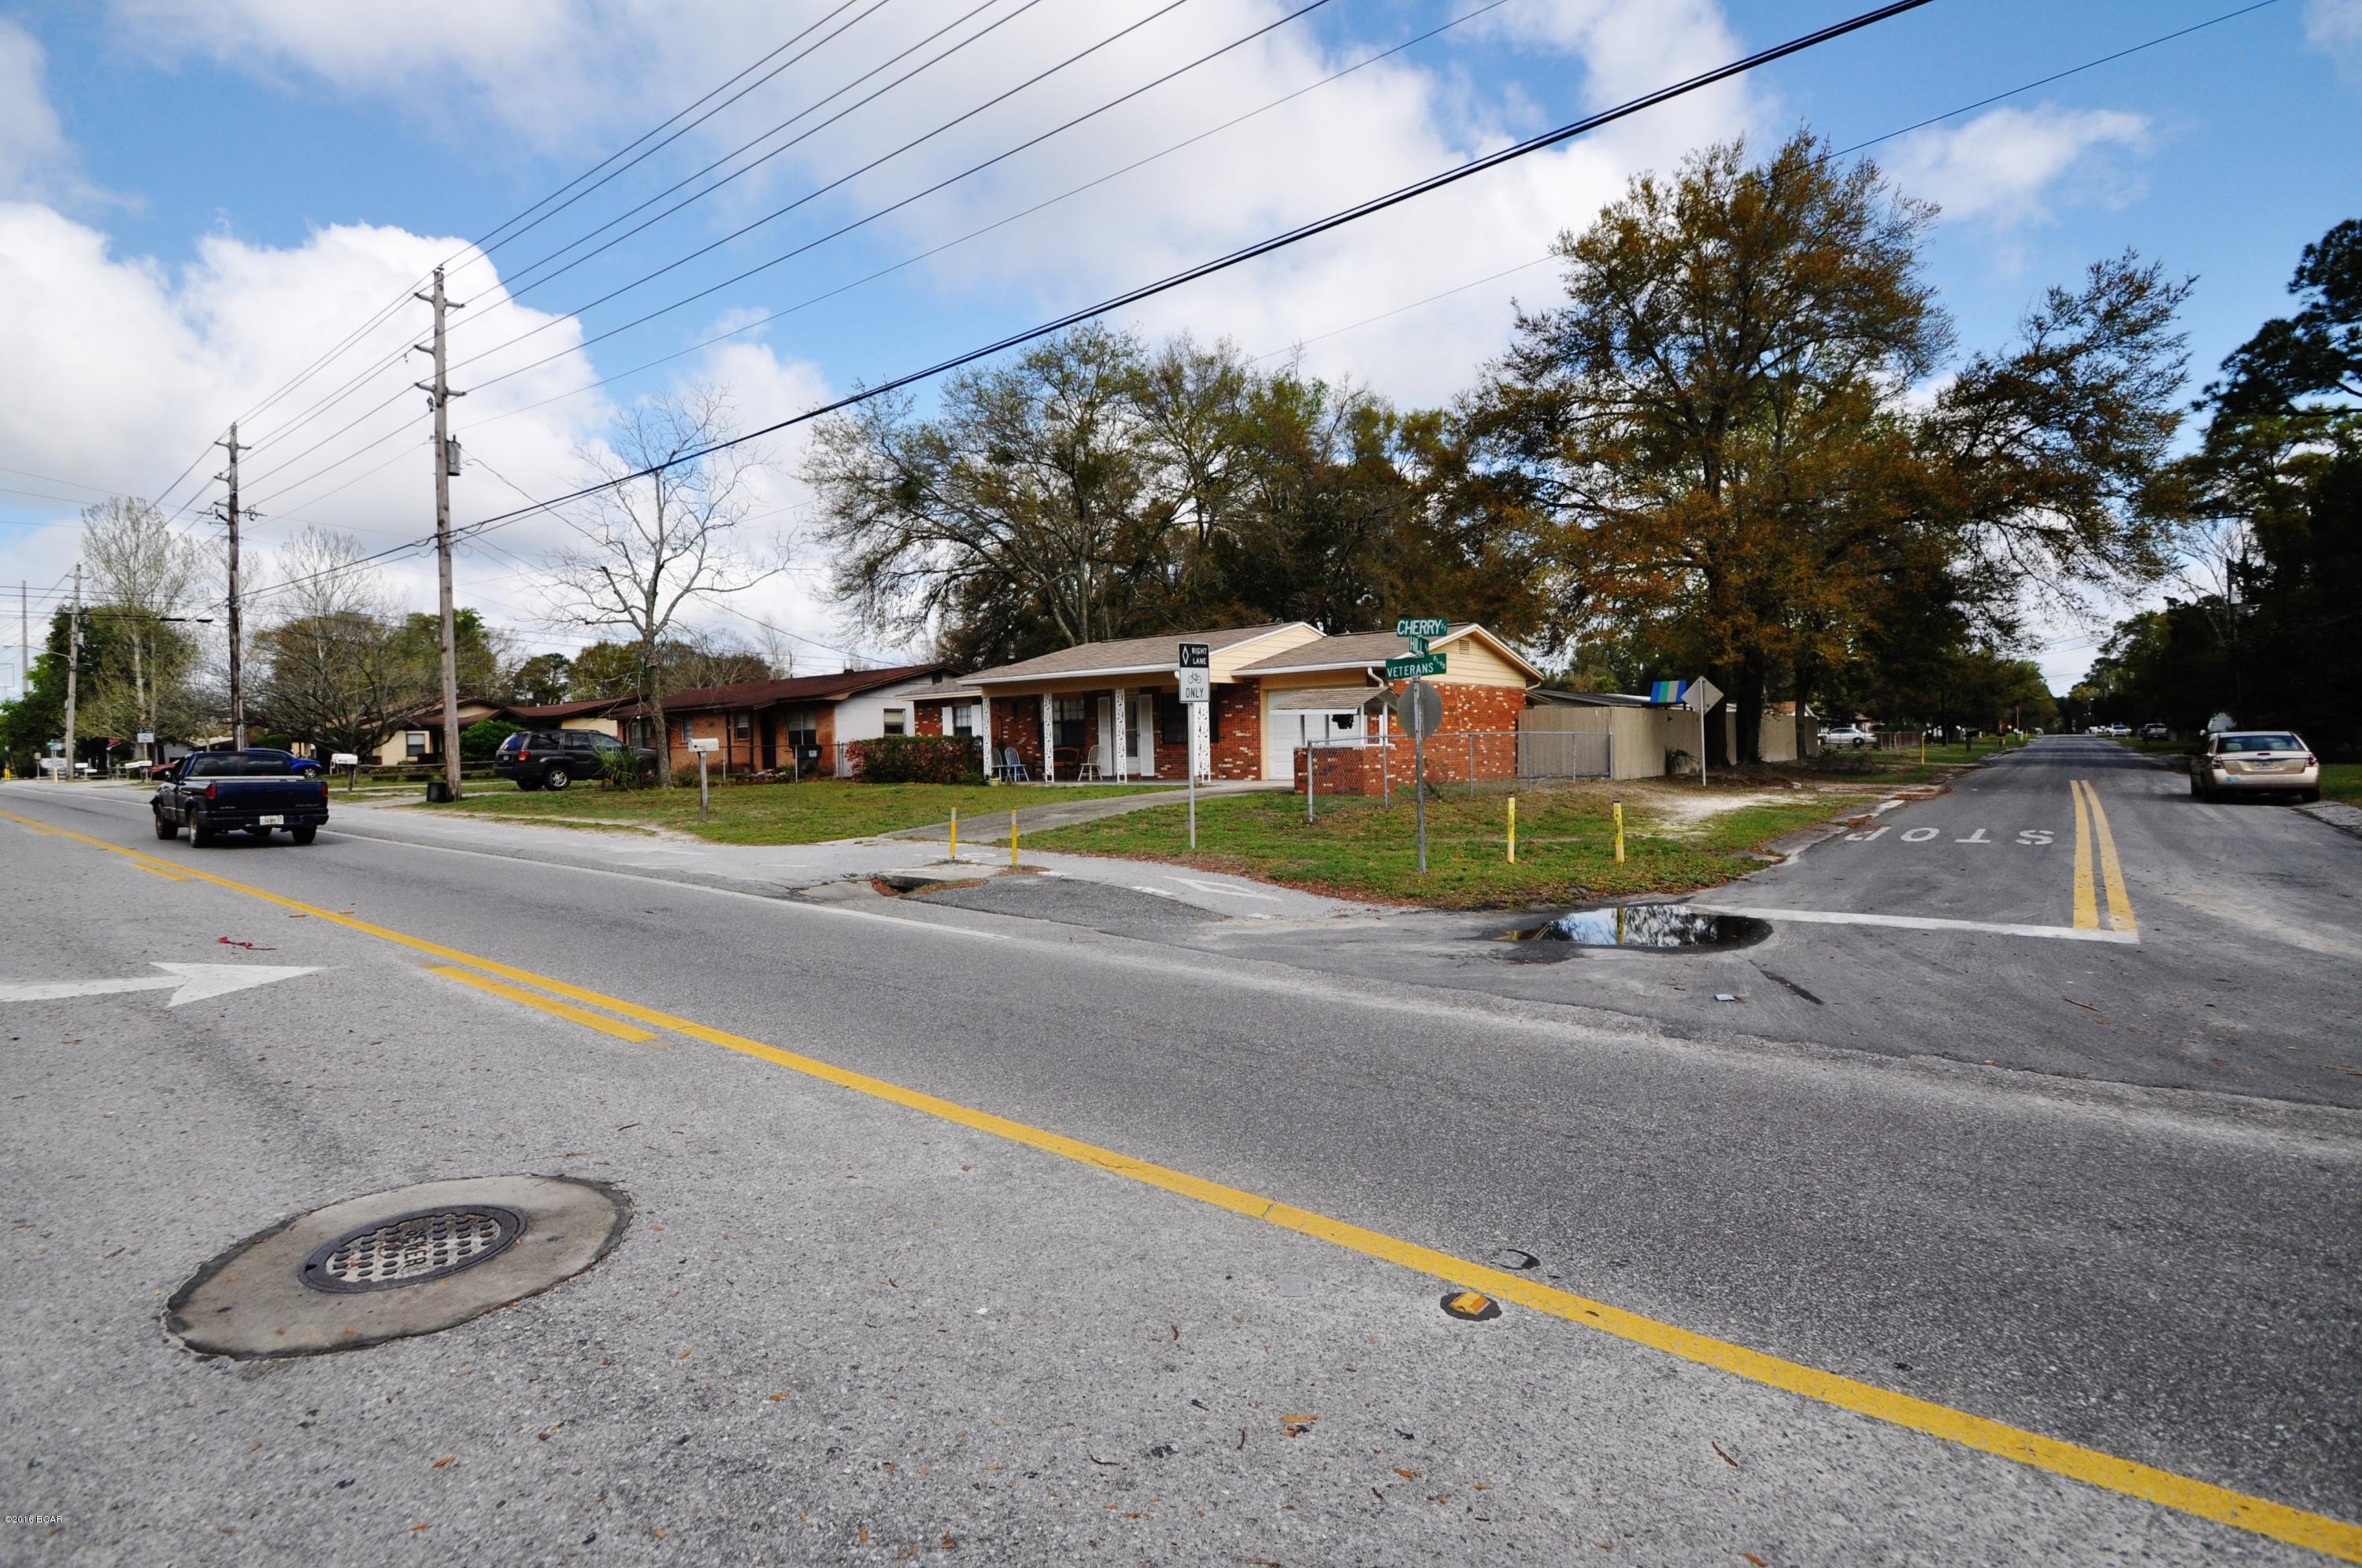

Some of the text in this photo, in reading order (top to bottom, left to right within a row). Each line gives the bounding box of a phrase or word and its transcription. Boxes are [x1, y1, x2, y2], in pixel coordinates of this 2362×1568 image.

[1398, 619, 1442, 634] CHERRY
[1410, 635, 1423, 654] HILL
[1387, 655, 1446, 678] VETERANS BLVD
[1185, 687, 1204, 698] ONLY
[404, 1229, 428, 1269] SEWER
